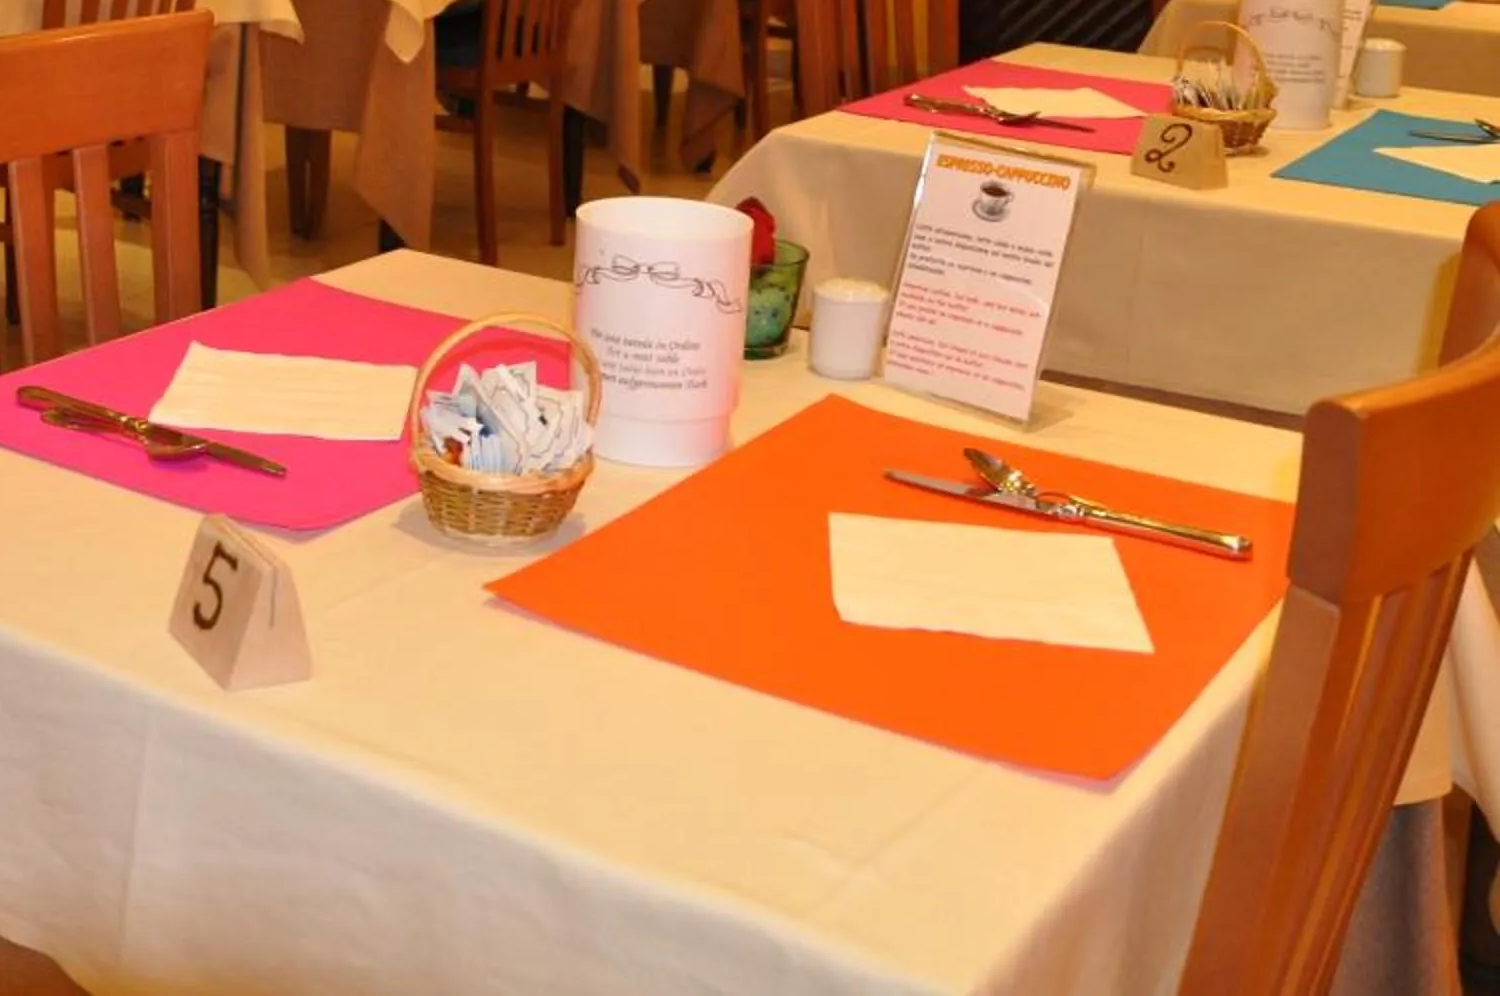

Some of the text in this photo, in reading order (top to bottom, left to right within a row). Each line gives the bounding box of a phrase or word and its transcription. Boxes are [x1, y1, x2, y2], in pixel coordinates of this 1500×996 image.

[937, 154, 1071, 190] ESPRESSO-CAPPUCCINO
[1143, 122, 1193, 174] 2
[192, 540, 239, 631] 5
